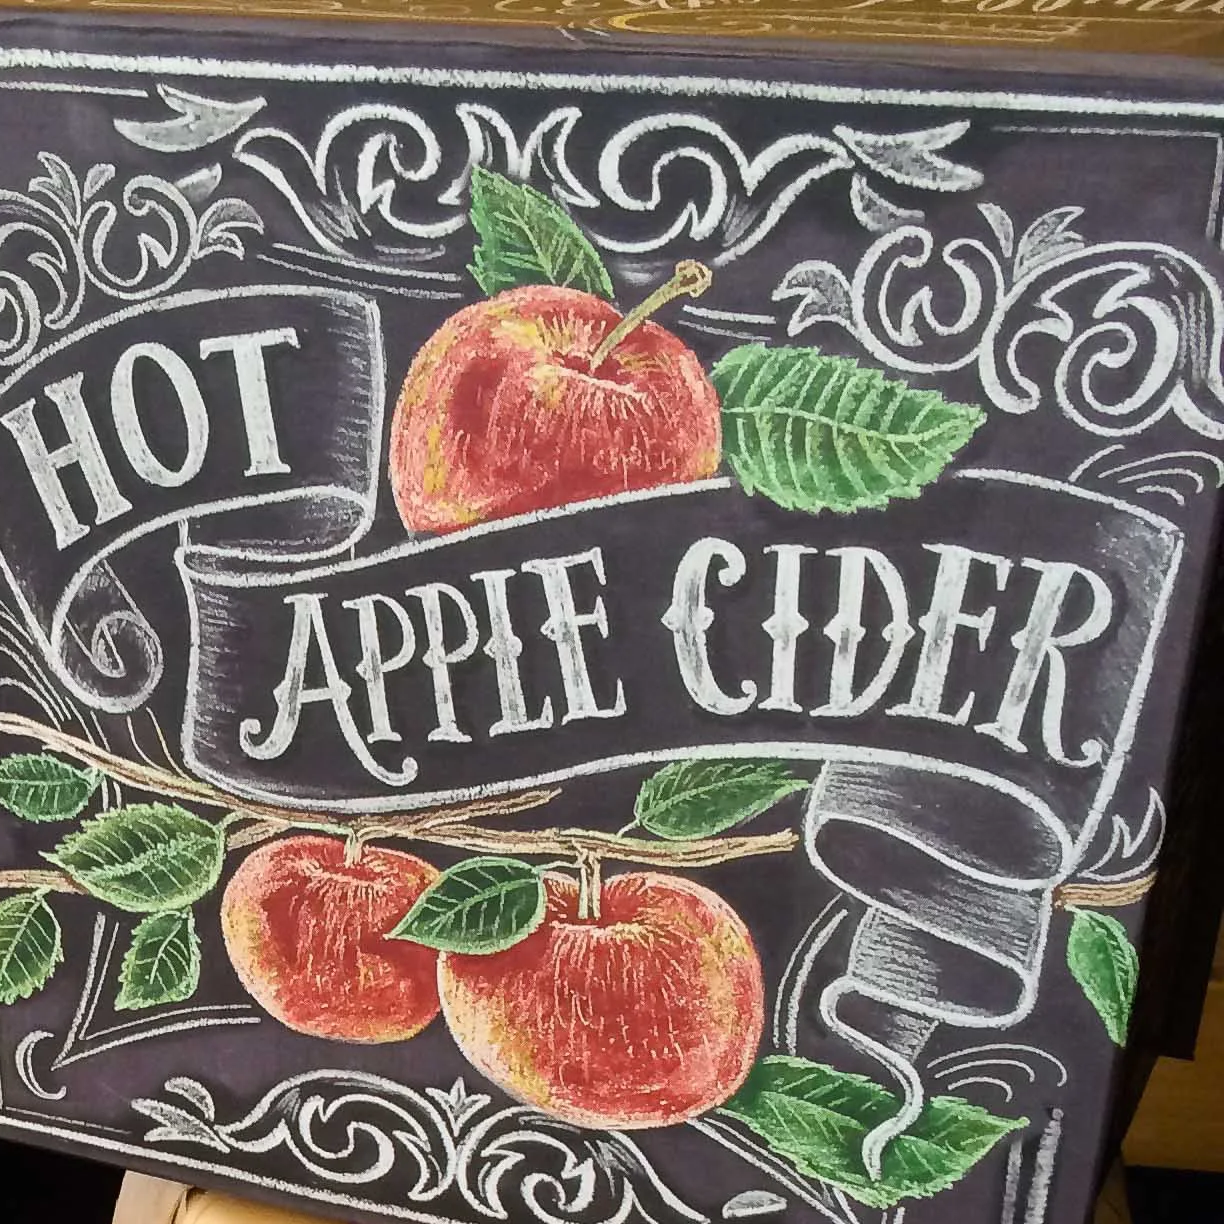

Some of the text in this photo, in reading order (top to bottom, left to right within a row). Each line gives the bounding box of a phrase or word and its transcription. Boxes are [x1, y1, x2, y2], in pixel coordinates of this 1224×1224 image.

[0, 326, 301, 552] HOT
[237, 536, 1114, 786] APPLE CIDER
